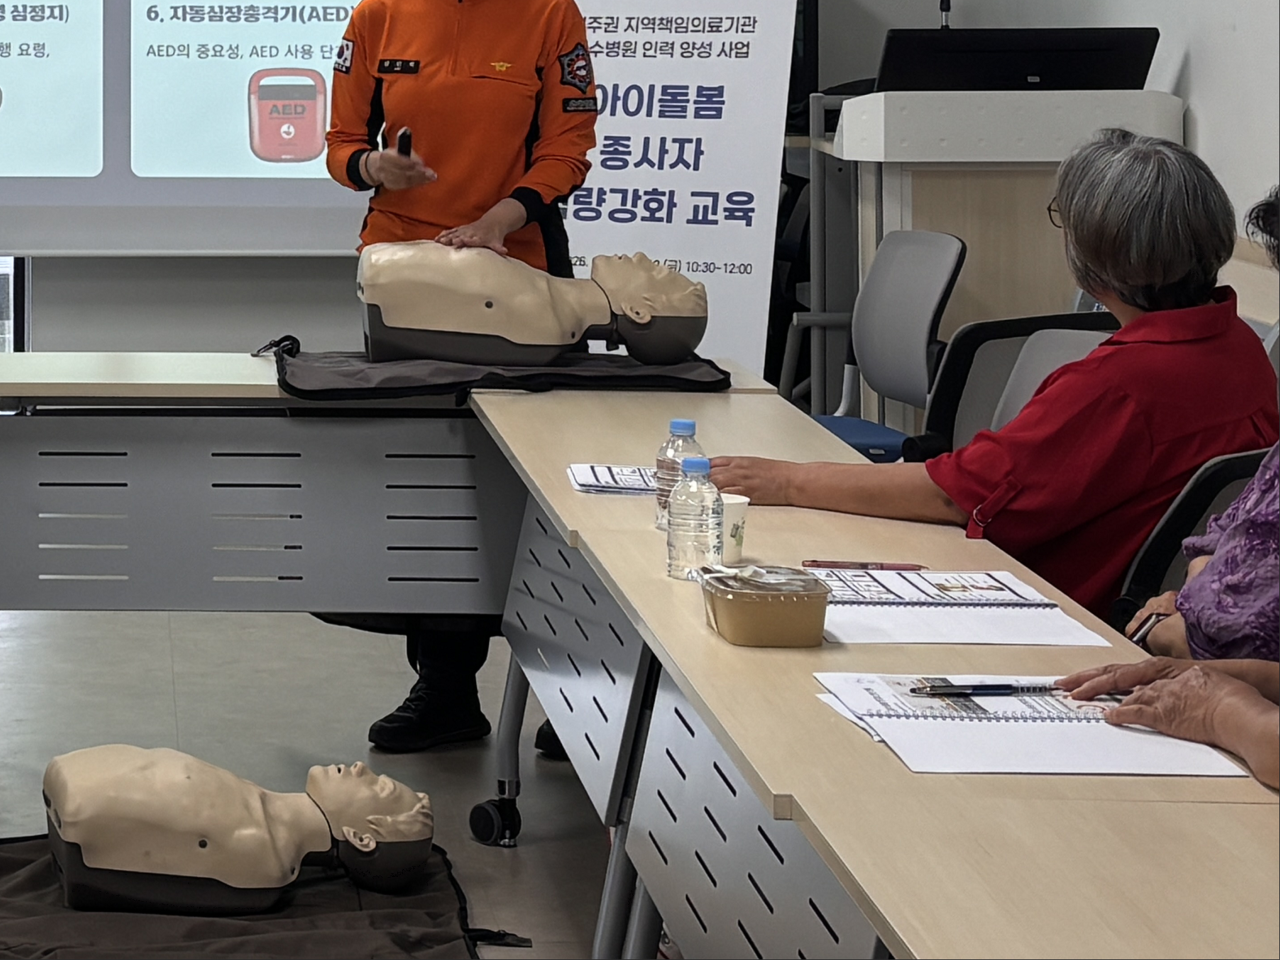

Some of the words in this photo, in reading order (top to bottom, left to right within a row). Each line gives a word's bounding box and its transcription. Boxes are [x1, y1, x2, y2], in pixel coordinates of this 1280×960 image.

[10, 4, 69, 23] 심정지)
[146, 5, 164, 22] 6.
[584, 16, 620, 34] 주권
[624, 16, 757, 34] 지역책임의료기관
[17, 42, 50, 58] 요령,
[146, 44, 190, 58] AED의
[196, 44, 244, 59] 중요성,
[249, 44, 279, 58] AED
[284, 44, 314, 59] 사용
[320, 44, 339, 59] 단
[589, 40, 637, 58] 수병원
[642, 41, 674, 58] 인력
[680, 41, 712, 58] 양성
[716, 41, 750, 59] 사업
[269, 104, 306, 116] AED
[596, 83, 726, 119] 아이돌봄
[599, 135, 705, 172] 종사자
[685, 190, 756, 227] 교육
[686, 261, 753, 275] 10:30~12:00
